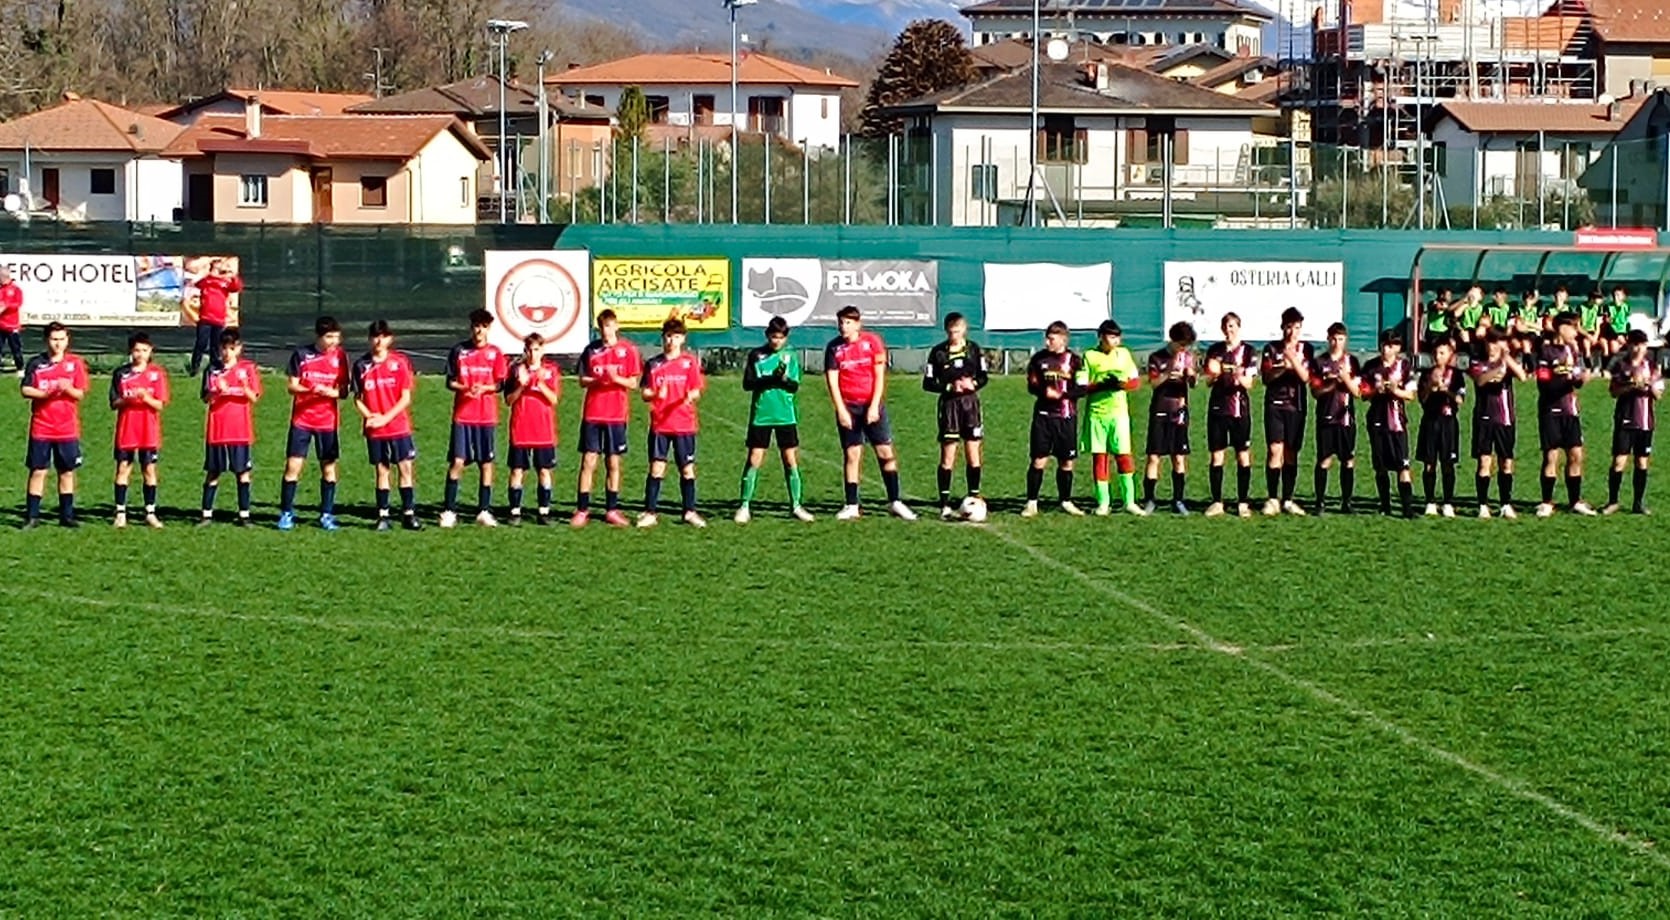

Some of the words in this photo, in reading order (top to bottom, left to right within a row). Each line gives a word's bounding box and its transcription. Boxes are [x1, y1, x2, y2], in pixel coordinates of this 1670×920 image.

[0, 262, 53, 282] ERO
[62, 262, 134, 283] HOTEL
[599, 264, 707, 277] AGRICOLA
[1230, 269, 1290, 287] OSTERIA
[1295, 269, 1337, 288] GALLI
[598, 277, 699, 292] ARCISATE
[826, 270, 931, 291] FELMOKA
